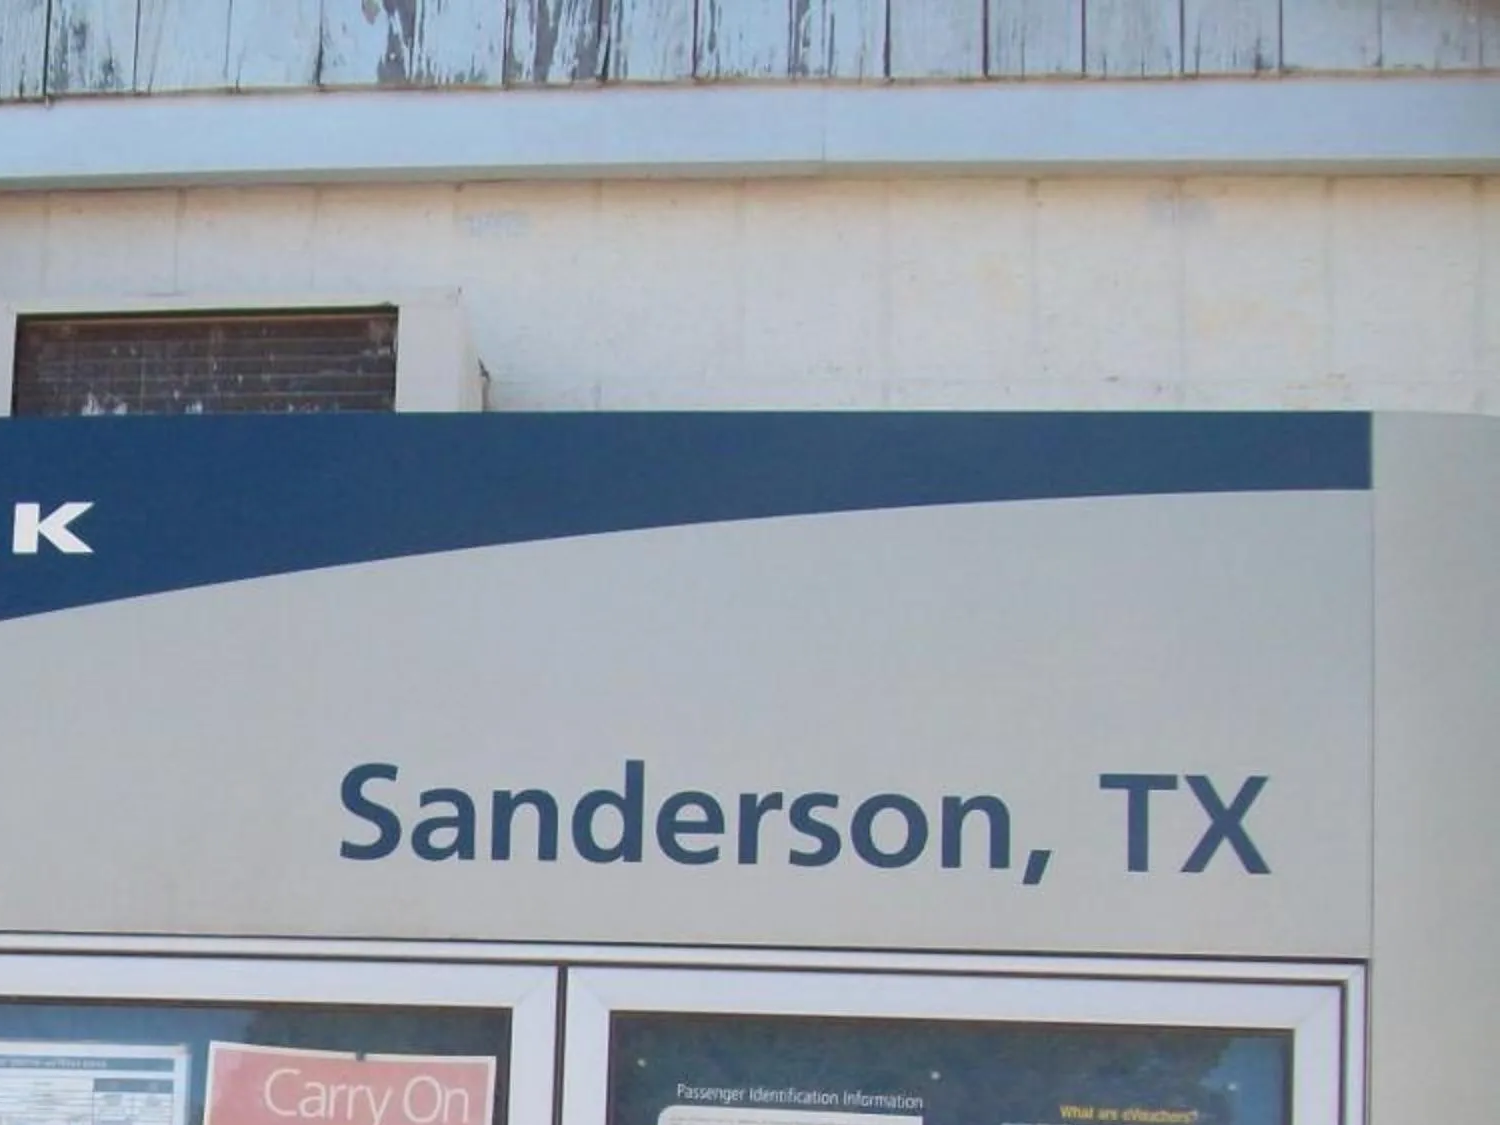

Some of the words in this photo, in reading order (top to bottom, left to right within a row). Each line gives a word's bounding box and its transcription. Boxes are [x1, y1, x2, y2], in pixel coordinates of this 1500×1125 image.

[339, 759, 1052, 885] Sanderson,
[1098, 773, 1271, 874] TX
[403, 1076, 469, 1124] On
[677, 1083, 745, 1103] Passenger
[750, 1089, 839, 1106] Identification
[844, 1092, 923, 1109] Information
[1060, 1106, 1093, 1120] What
[1099, 1109, 1118, 1121] are
